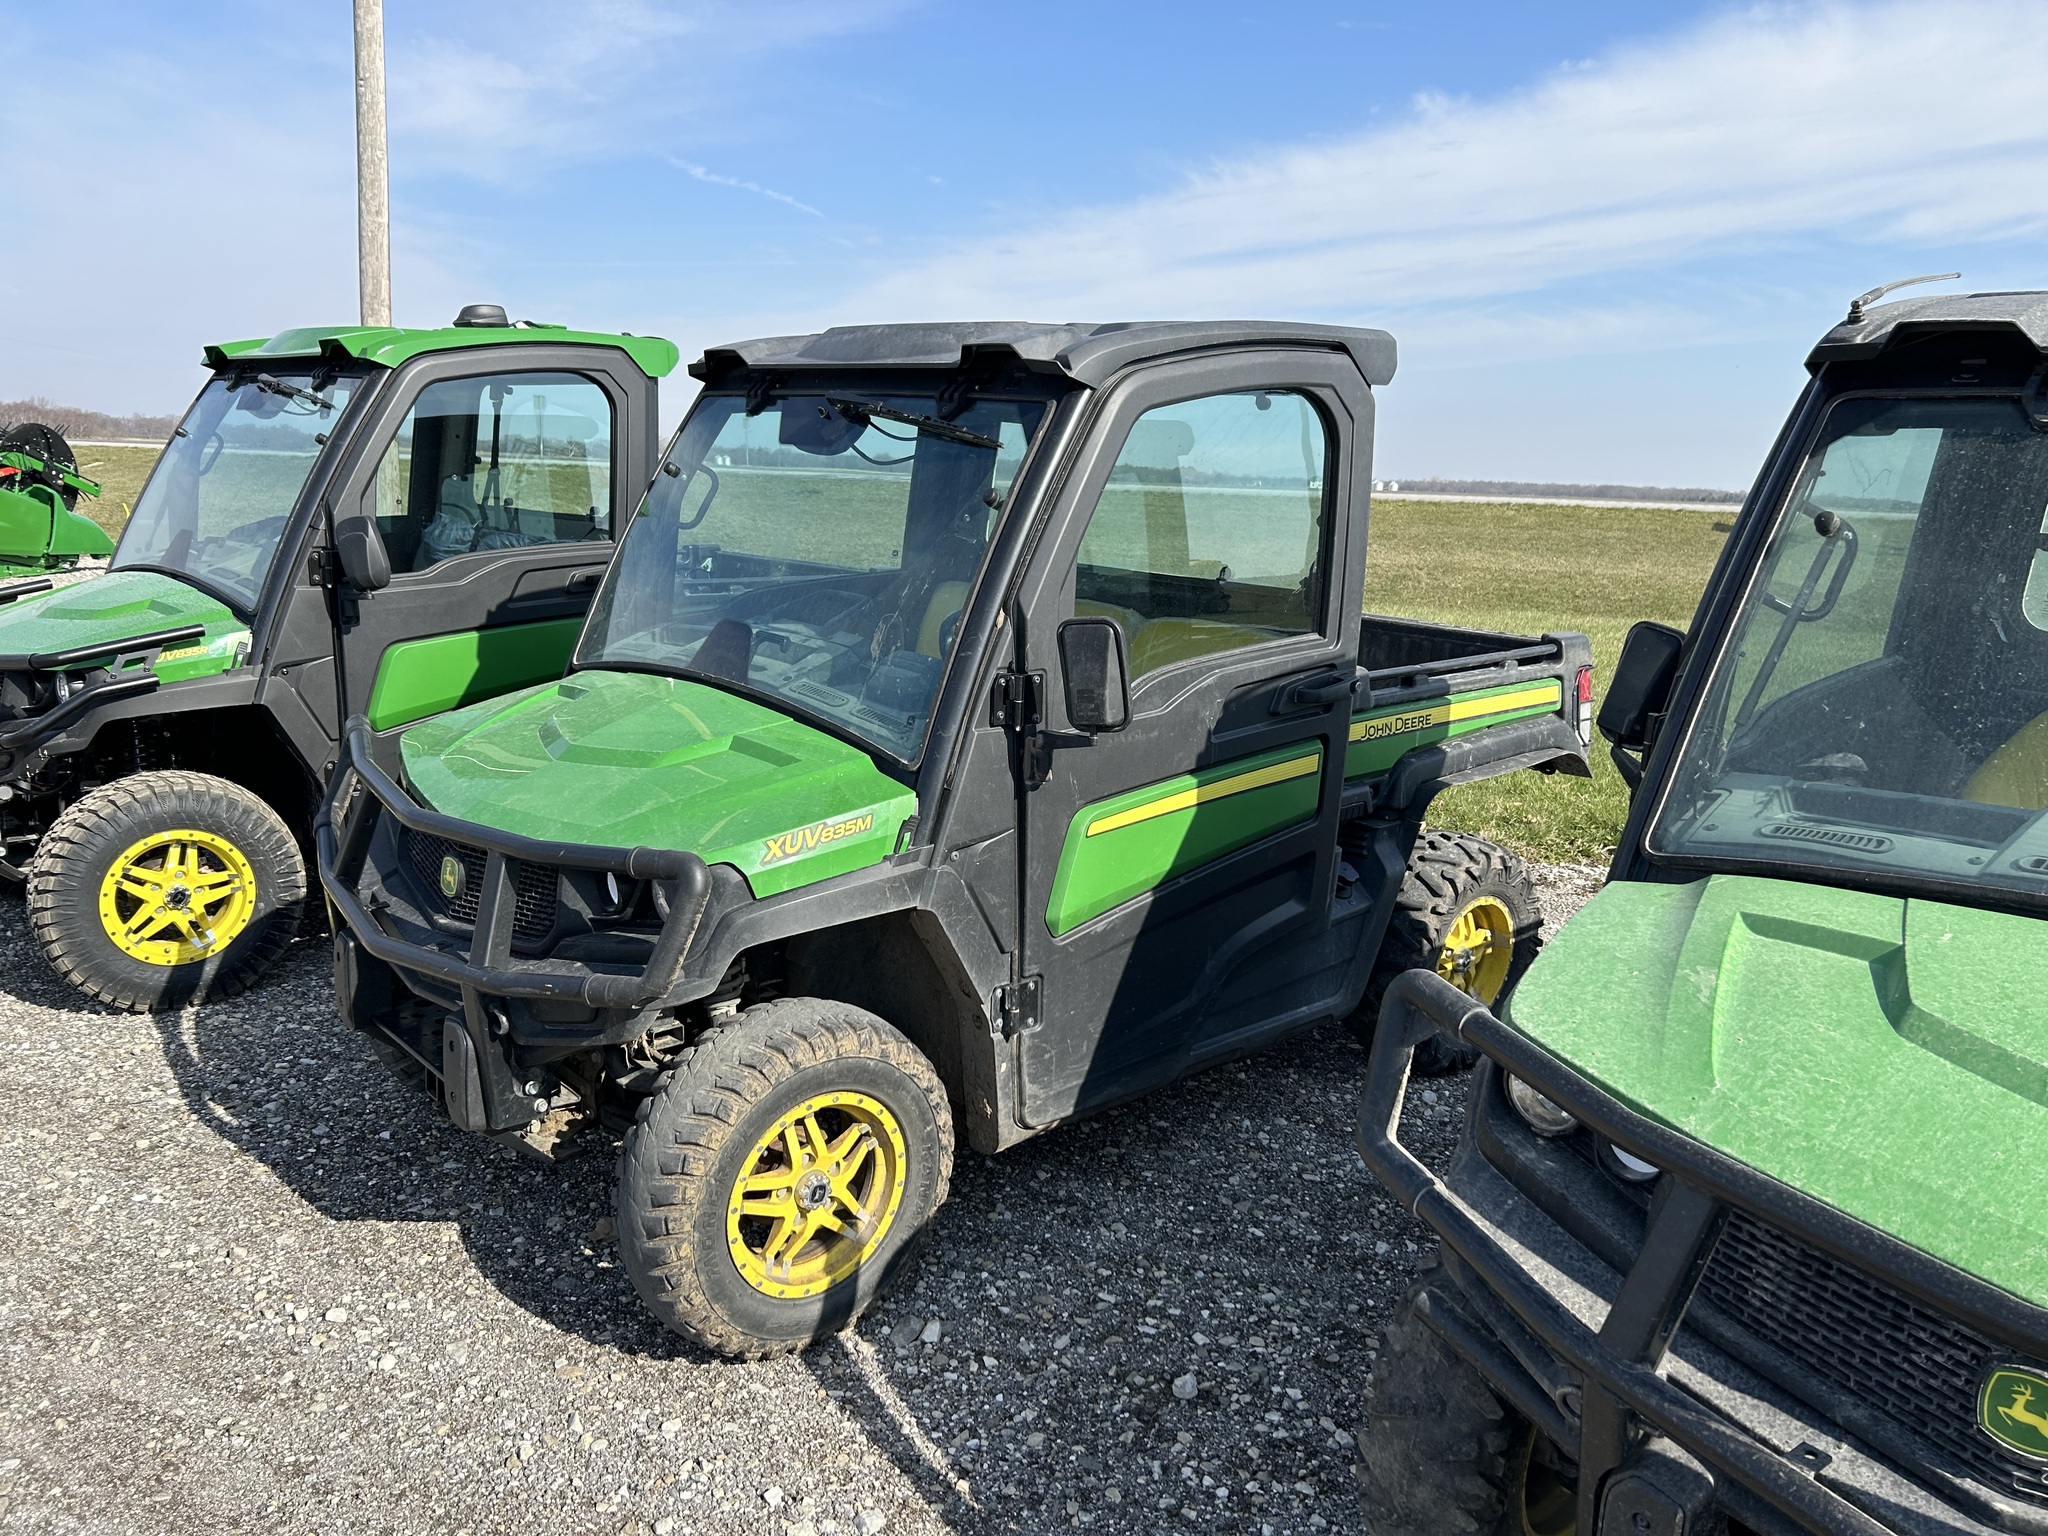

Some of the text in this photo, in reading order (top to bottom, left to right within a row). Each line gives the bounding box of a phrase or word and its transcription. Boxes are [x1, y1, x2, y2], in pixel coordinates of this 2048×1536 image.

[1361, 714, 1432, 740] JOHN DEERE
[763, 814, 873, 863] XUV835M
